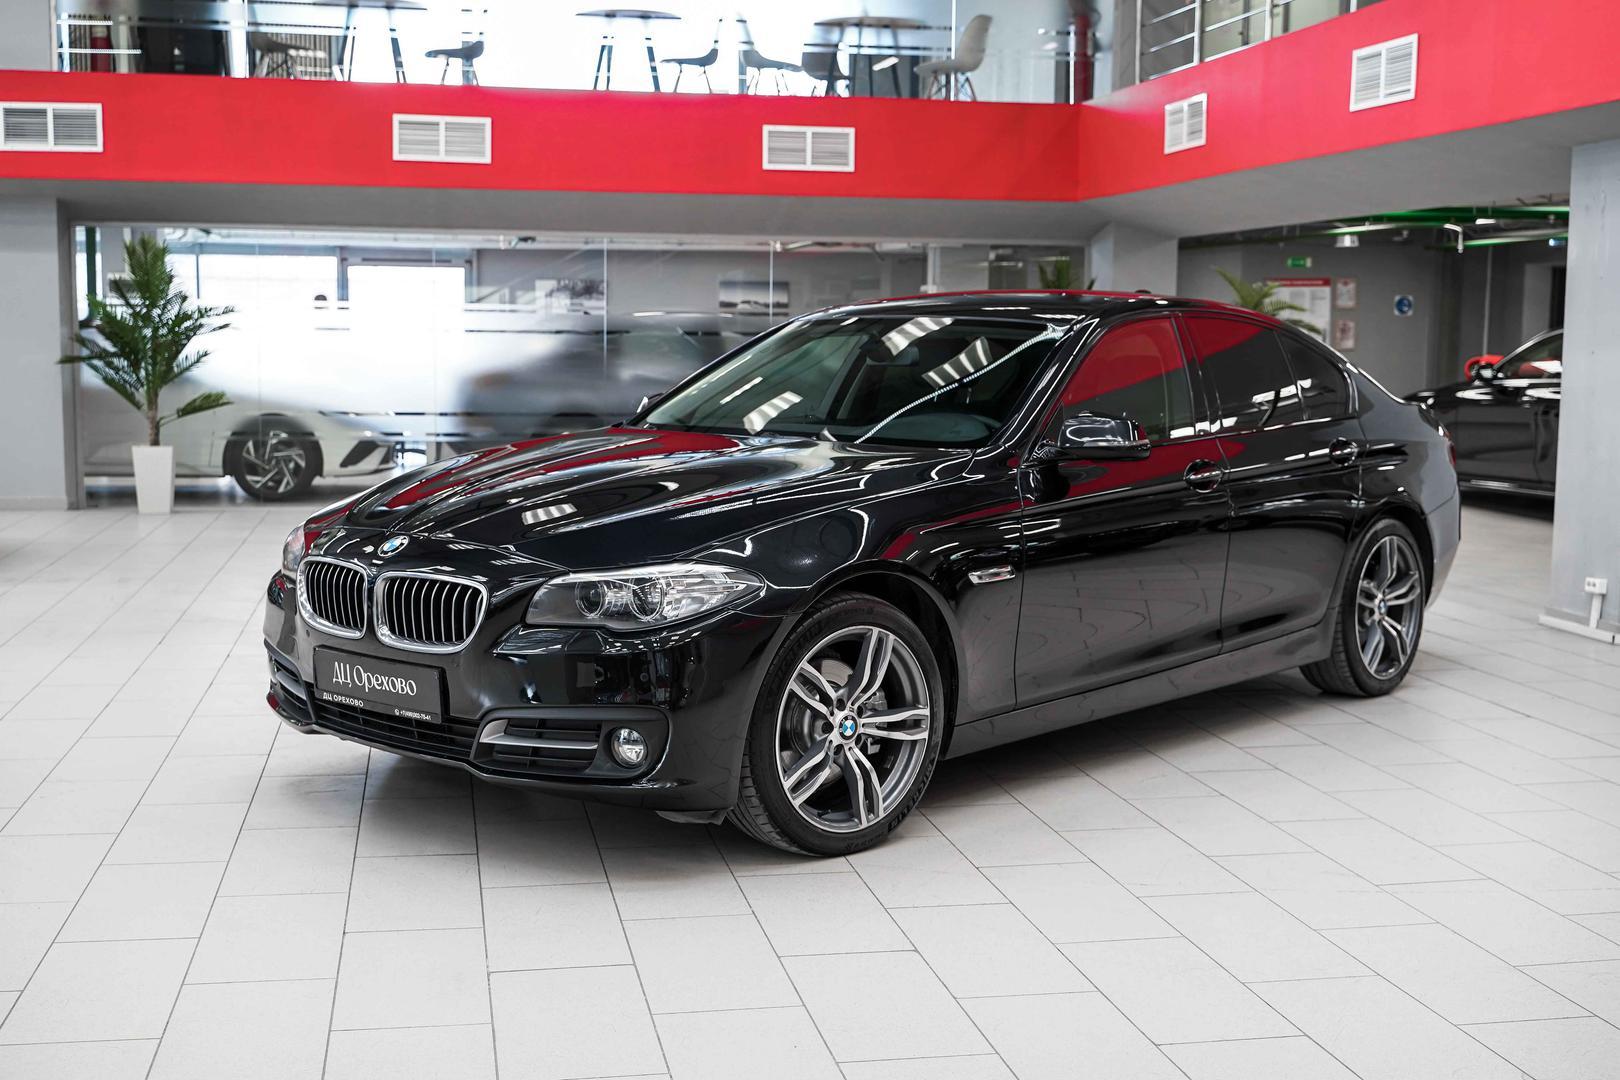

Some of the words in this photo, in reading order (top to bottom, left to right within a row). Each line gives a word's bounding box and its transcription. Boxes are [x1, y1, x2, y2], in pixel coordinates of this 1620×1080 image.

[333, 661, 352, 687] ДЦ
[354, 665, 416, 696] Орехово
[323, 692, 333, 701] ДЦ
[333, 695, 364, 707] ОРЕХОВО
